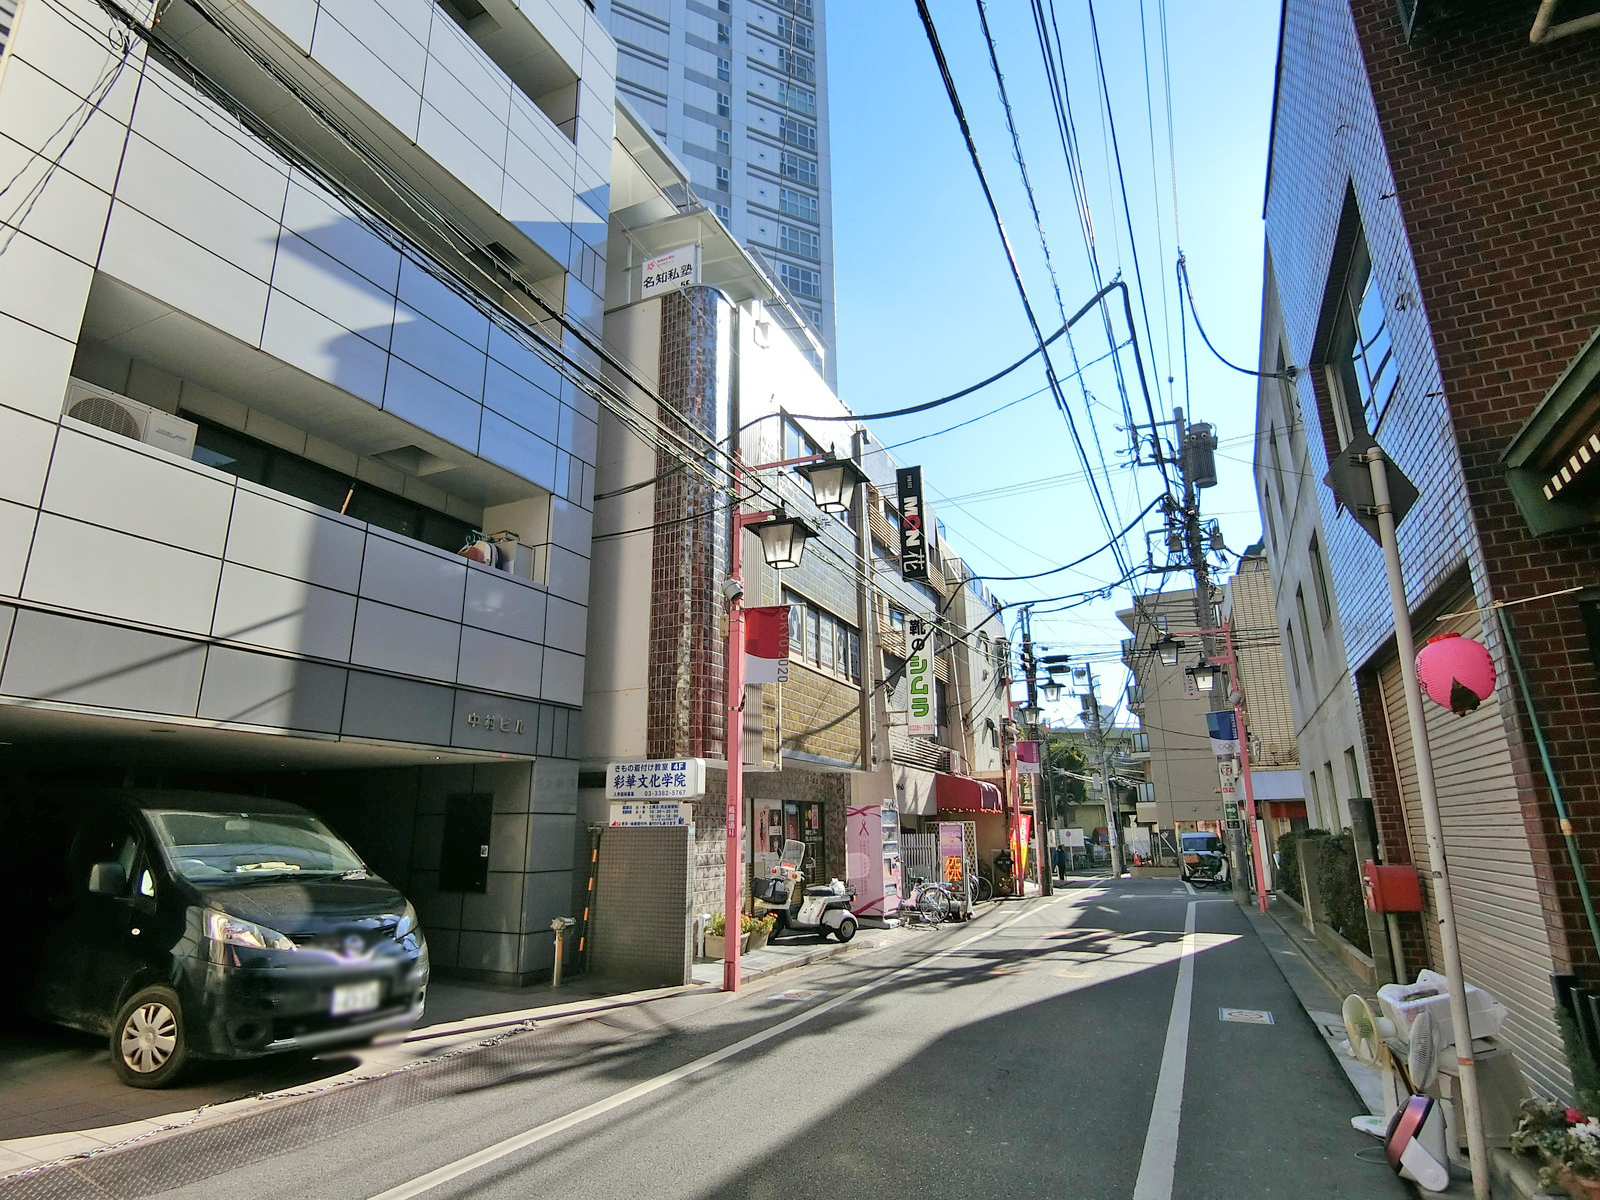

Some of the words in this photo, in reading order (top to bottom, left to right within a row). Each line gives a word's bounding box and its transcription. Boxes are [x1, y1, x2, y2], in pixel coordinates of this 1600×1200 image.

[643, 263, 692, 289] 名知私塾
[777, 650, 790, 683] 2020
[614, 763, 669, 773] きもの着付け教室
[671, 762, 686, 771] 4F
[613, 772, 687, 790] 彩華文化学院
